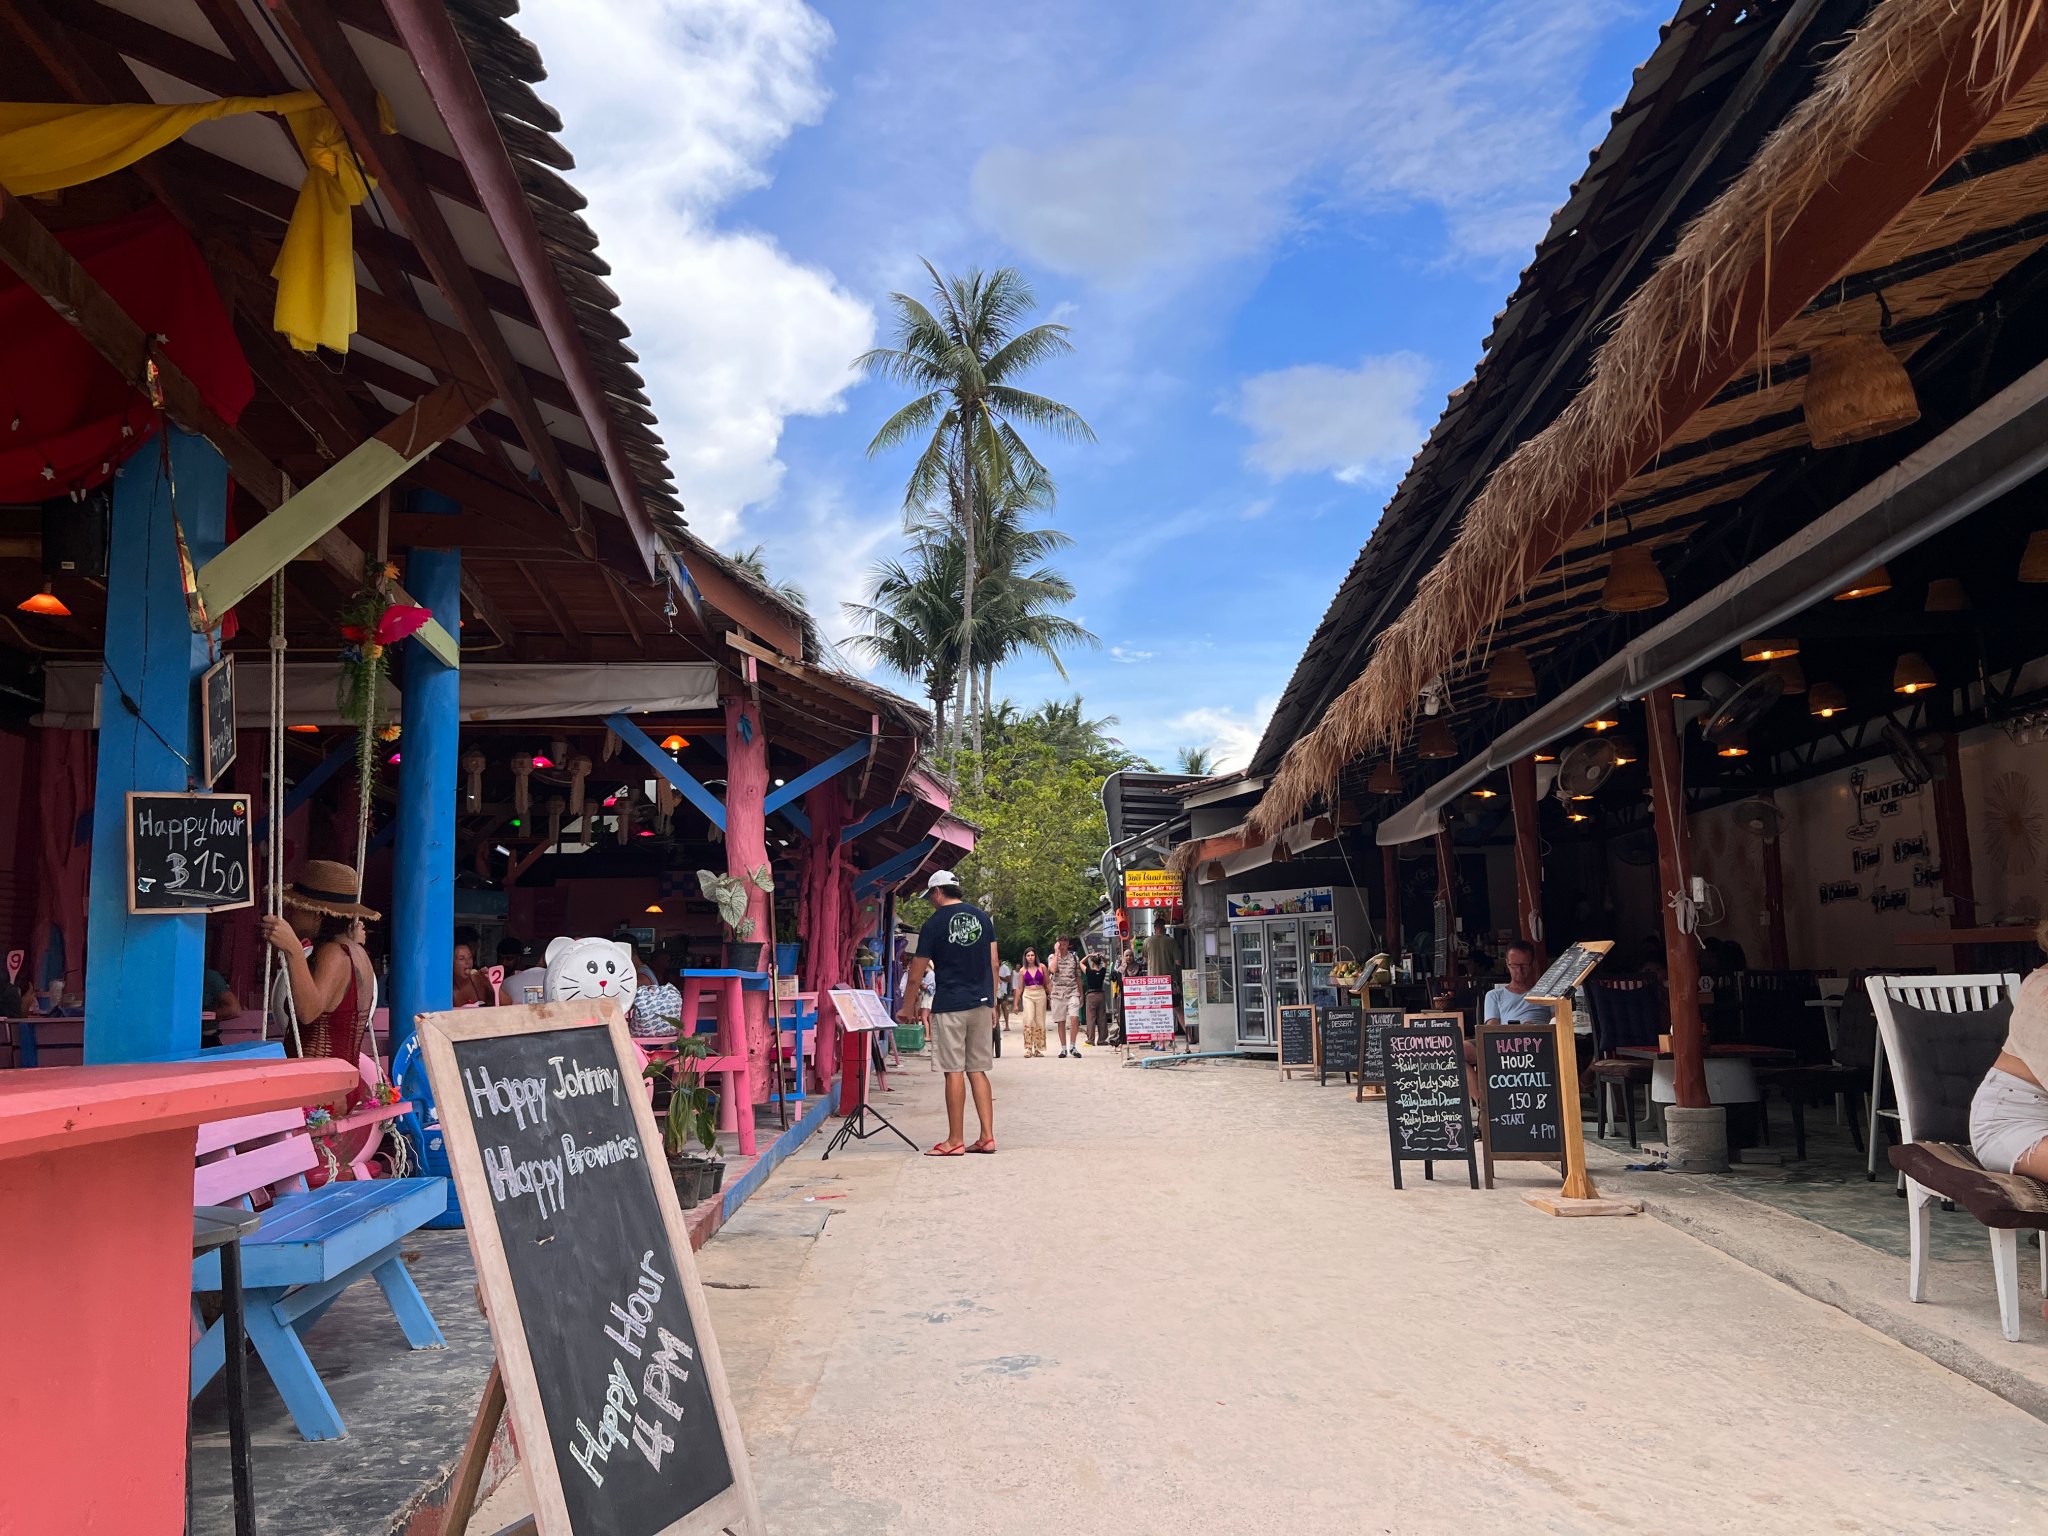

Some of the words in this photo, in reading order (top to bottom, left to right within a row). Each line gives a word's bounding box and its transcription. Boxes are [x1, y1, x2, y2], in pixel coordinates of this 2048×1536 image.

[138, 808, 208, 851] Happy
[210, 807, 245, 837] hour
[9, 953, 21, 970] 9
[492, 970, 502, 984] 2
[1331, 1020, 1353, 1028] DESSERT
[1390, 1036, 1453, 1051] RECOMMEND
[1496, 1037, 1543, 1054] HAPPY
[1419, 1057, 1441, 1071] beach
[1500, 1054, 1535, 1069] HOUR
[1399, 1077, 1420, 1093] Sexy
[1418, 1076, 1439, 1093] lady
[1489, 1072, 1552, 1089] COCKTAIL
[464, 1065, 547, 1129] Happy
[547, 1056, 620, 1107] Johnny
[1419, 1093, 1438, 1107] beach
[1508, 1092, 1531, 1110] 150
[1421, 1110, 1441, 1123] beach
[1500, 1113, 1526, 1126] START
[1529, 1124, 1538, 1139] 4
[483, 1144, 567, 1220] Happy
[561, 1132, 639, 1177] Brownies
[569, 1357, 639, 1488] Happy
[604, 1249, 666, 1359] Hour
[642, 1327, 694, 1421] PM
[632, 1412, 676, 1474] 4
